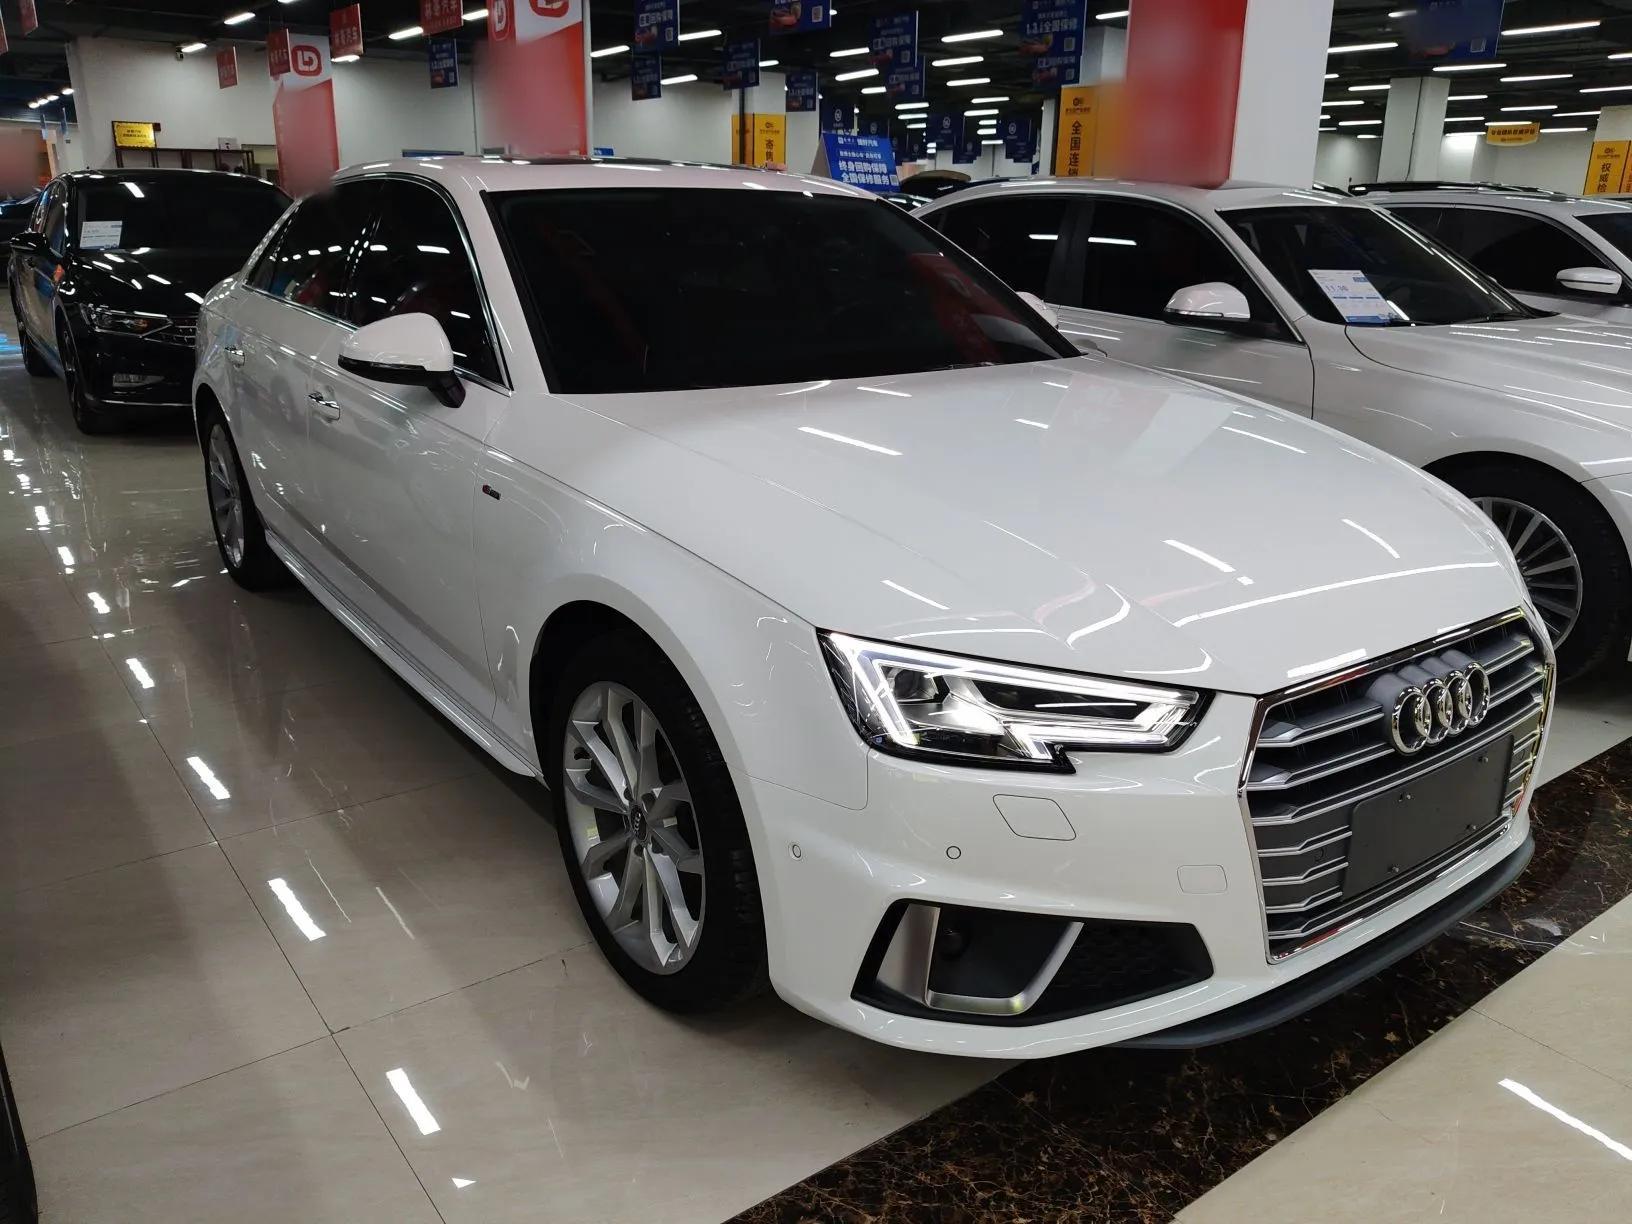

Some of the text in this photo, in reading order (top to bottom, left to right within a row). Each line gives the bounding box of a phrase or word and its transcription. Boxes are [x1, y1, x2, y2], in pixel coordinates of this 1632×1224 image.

[838, 160, 888, 174] 终身回购保障
[841, 172, 890, 185] 全国保修服务
